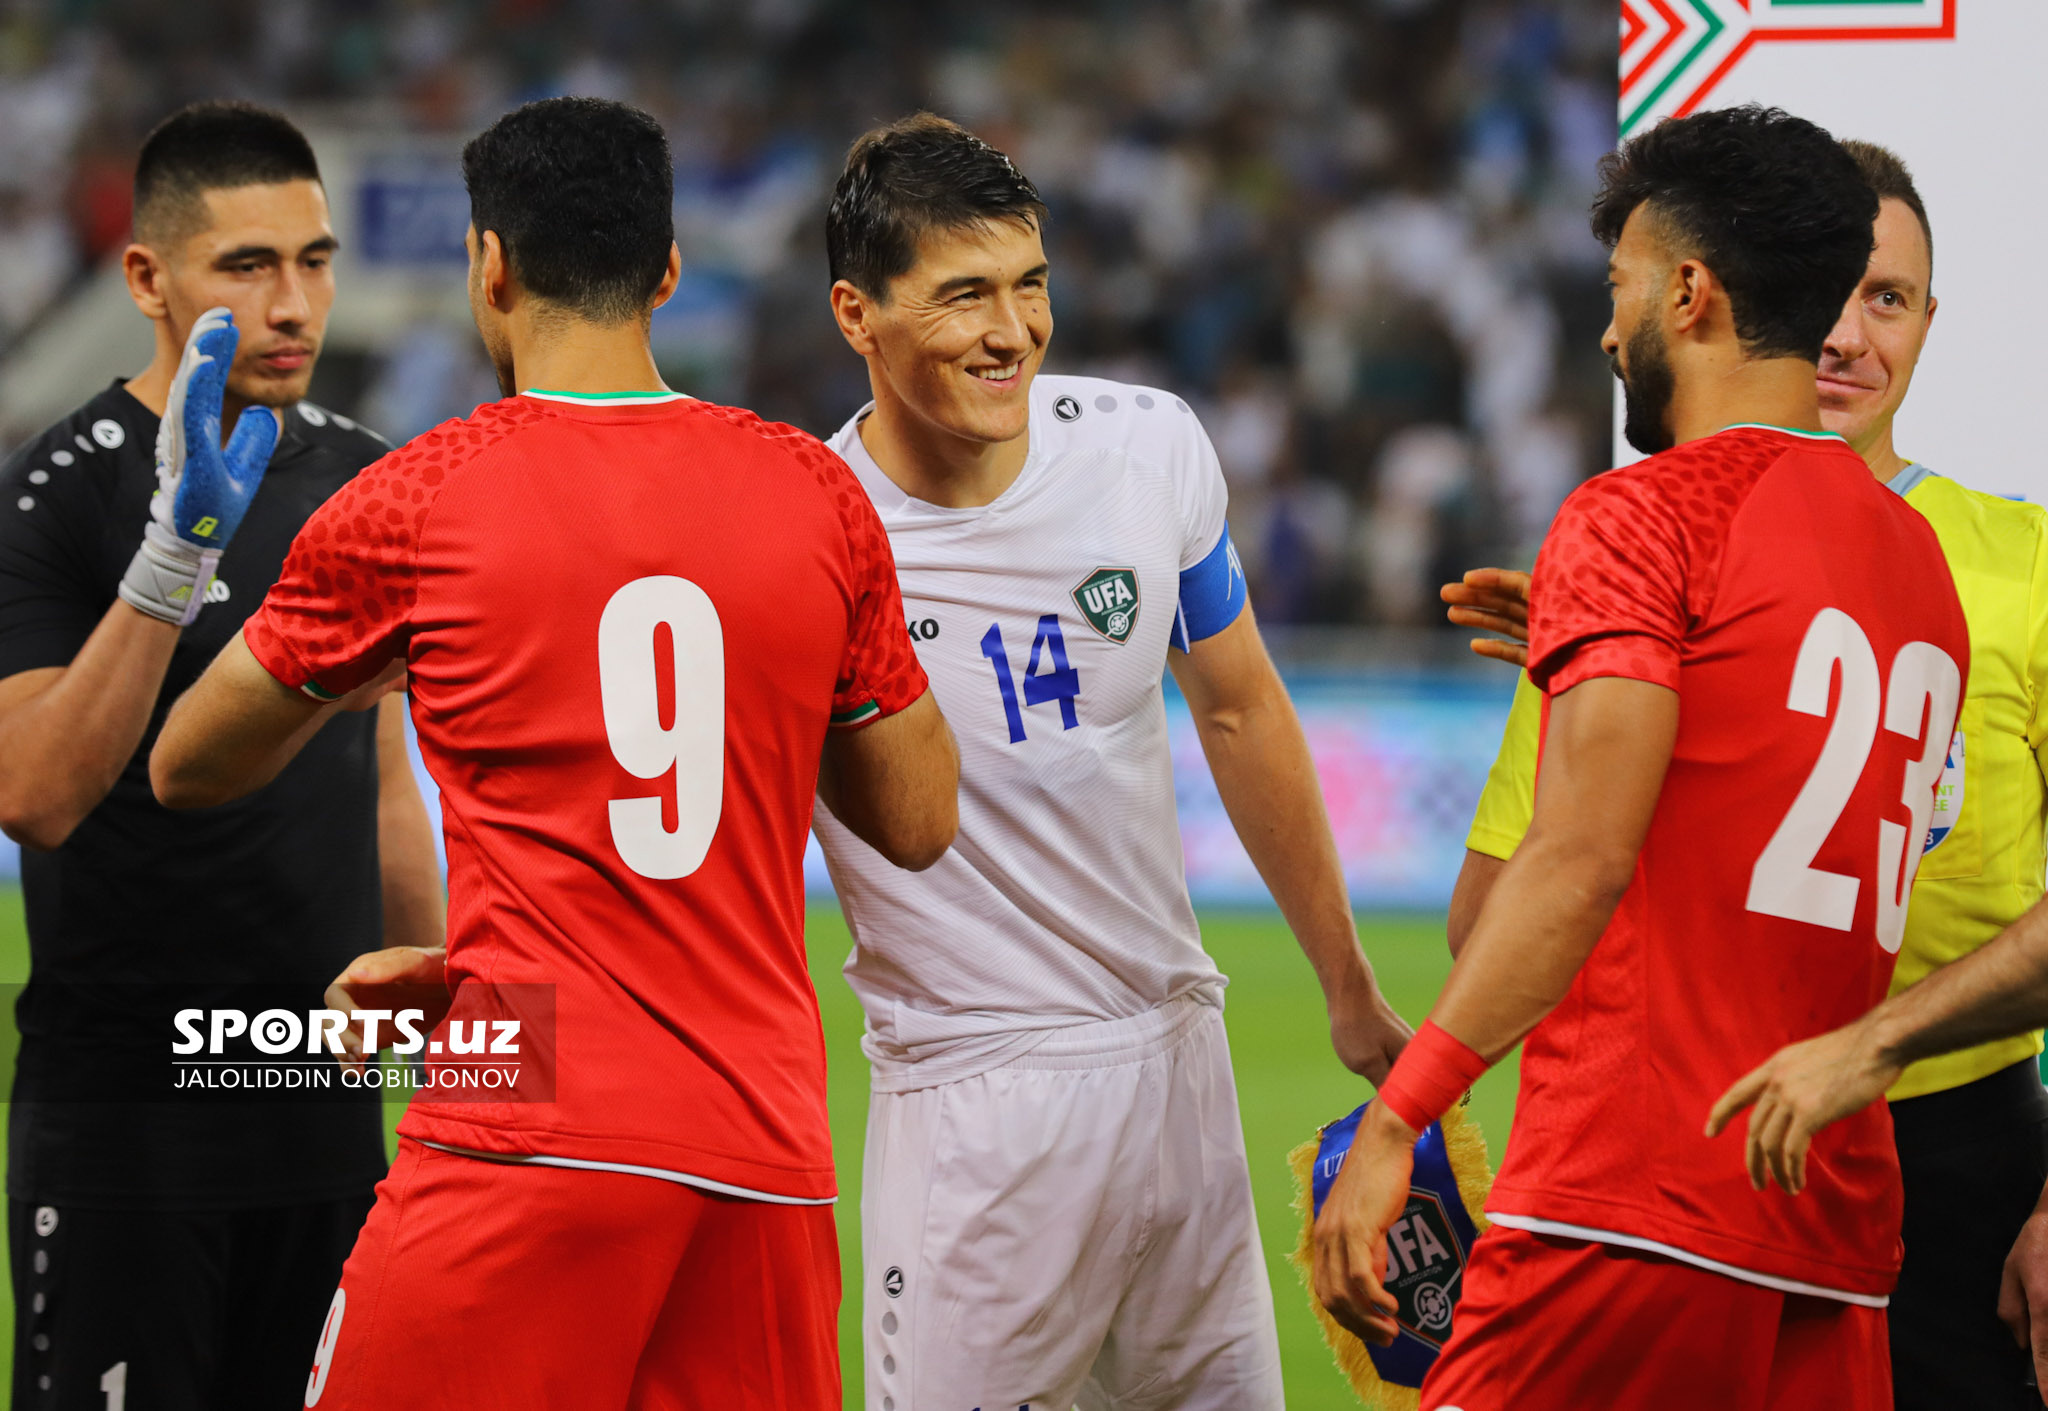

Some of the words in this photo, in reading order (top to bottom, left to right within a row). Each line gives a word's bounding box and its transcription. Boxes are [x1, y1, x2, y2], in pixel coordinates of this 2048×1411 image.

[908, 618, 940, 642] KO
[1083, 577, 1134, 614] UFA
[598, 575, 725, 880] 9
[980, 613, 1080, 744] 14
[1745, 606, 1961, 955] 23
[304, 1287, 346, 1408] 9
